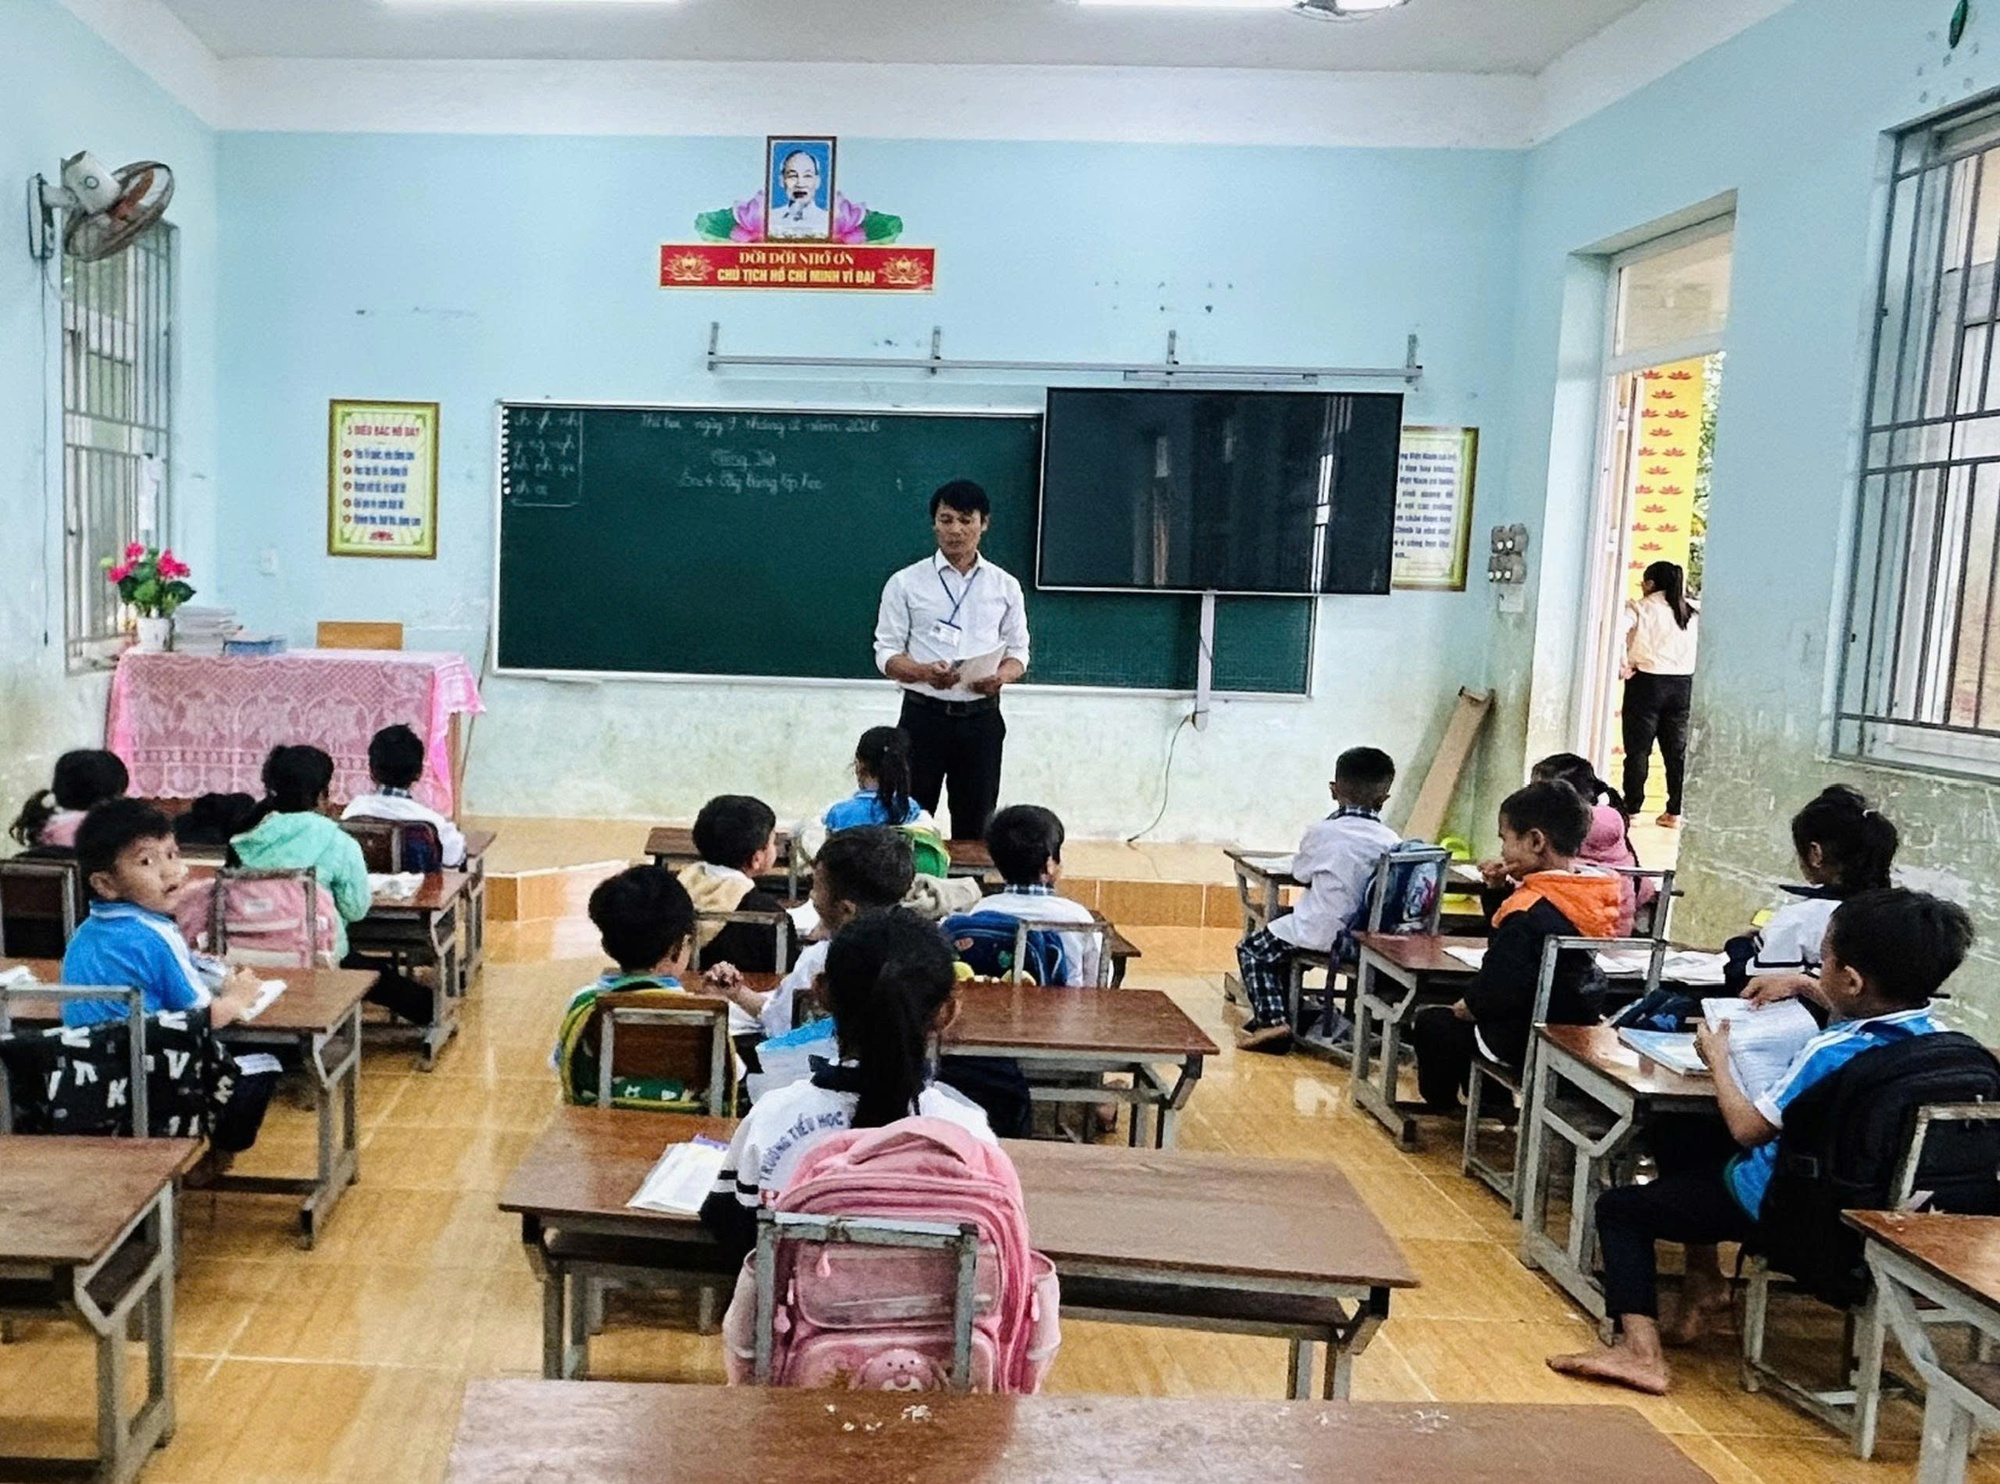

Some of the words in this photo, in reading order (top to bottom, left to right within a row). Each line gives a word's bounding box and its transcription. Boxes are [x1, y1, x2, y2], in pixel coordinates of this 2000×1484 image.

[717, 267, 741, 282] CHỦ
[742, 269, 767, 285] TỊCH
[769, 267, 786, 283] HỒ
[787, 268, 807, 284] CHÍ
[809, 270, 840, 284] MINH
[787, 1112, 816, 1141] TIỂU
[816, 1111, 844, 1128] HỌC
